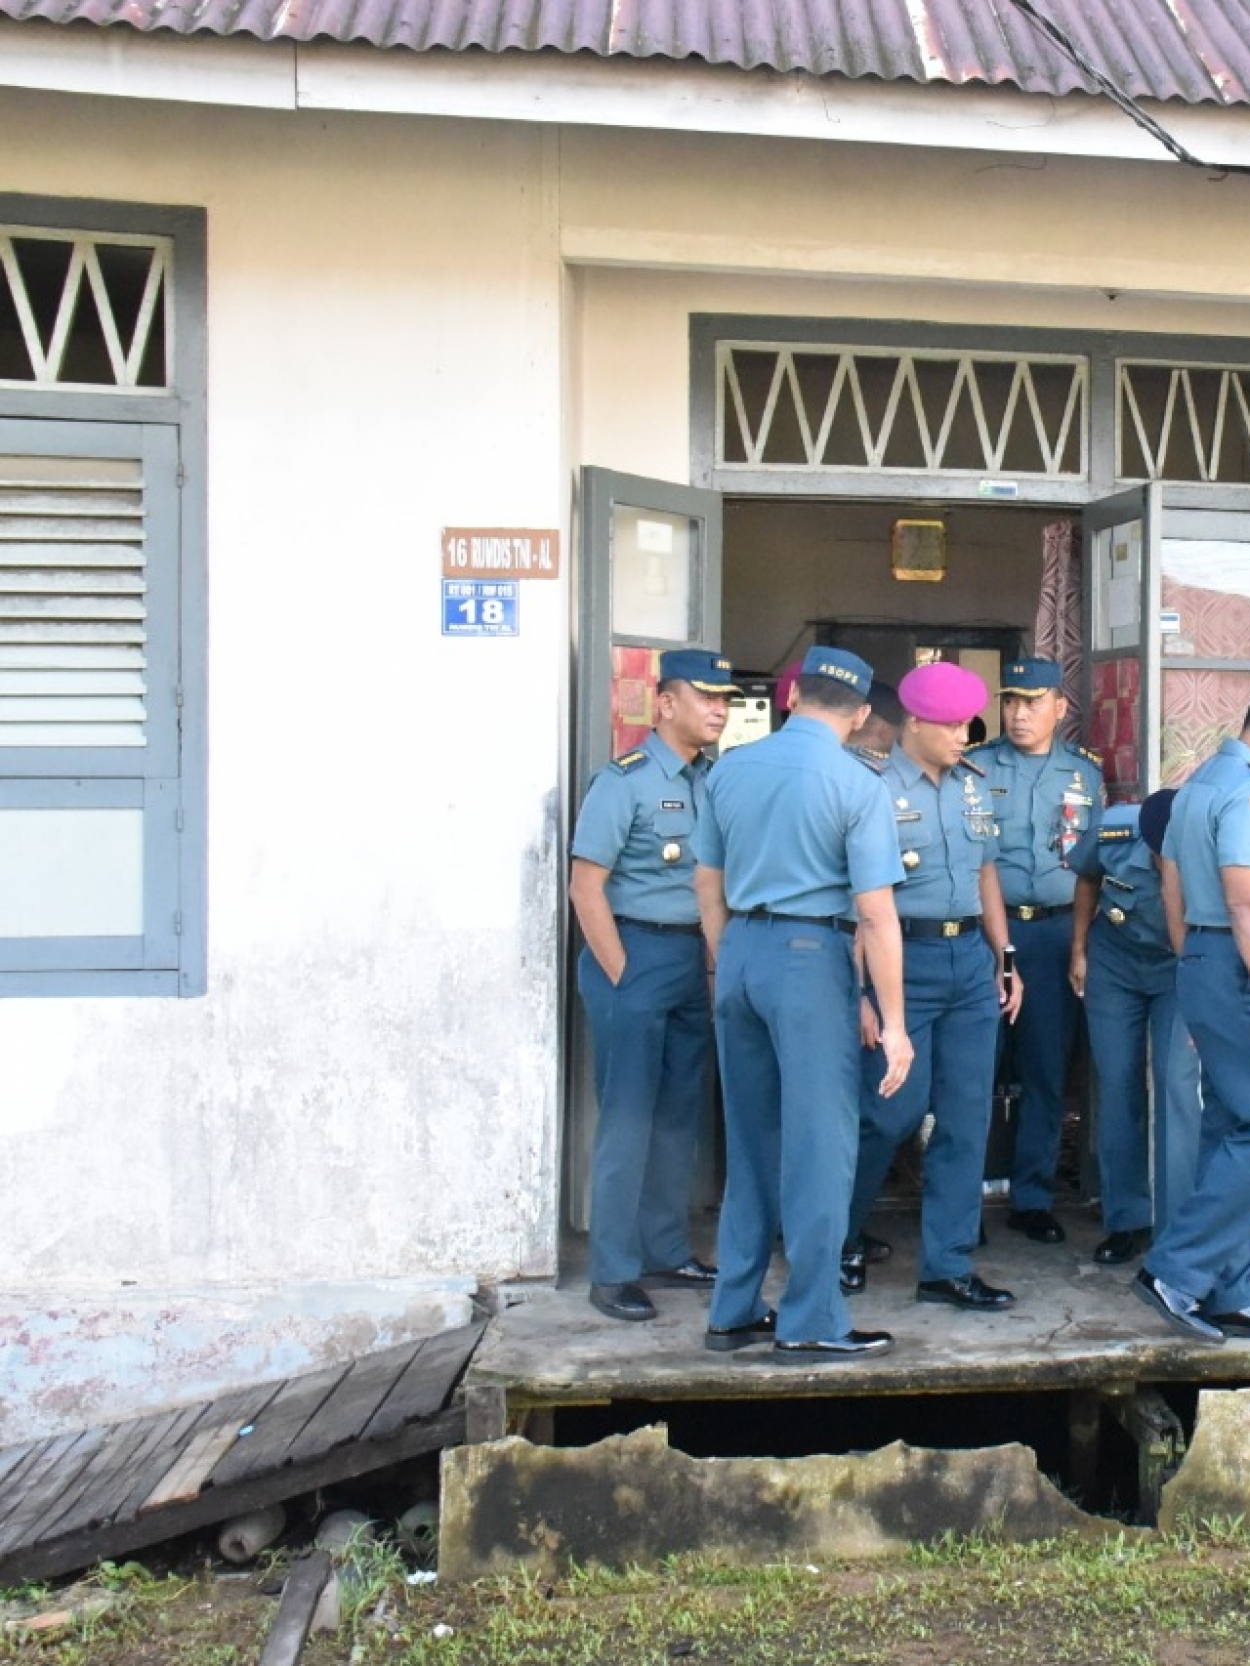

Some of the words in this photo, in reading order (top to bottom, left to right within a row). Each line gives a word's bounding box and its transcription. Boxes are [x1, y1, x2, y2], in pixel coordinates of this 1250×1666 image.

[447, 537, 468, 567] 16
[539, 538, 554, 570] AL
[458, 599, 505, 624] 18
